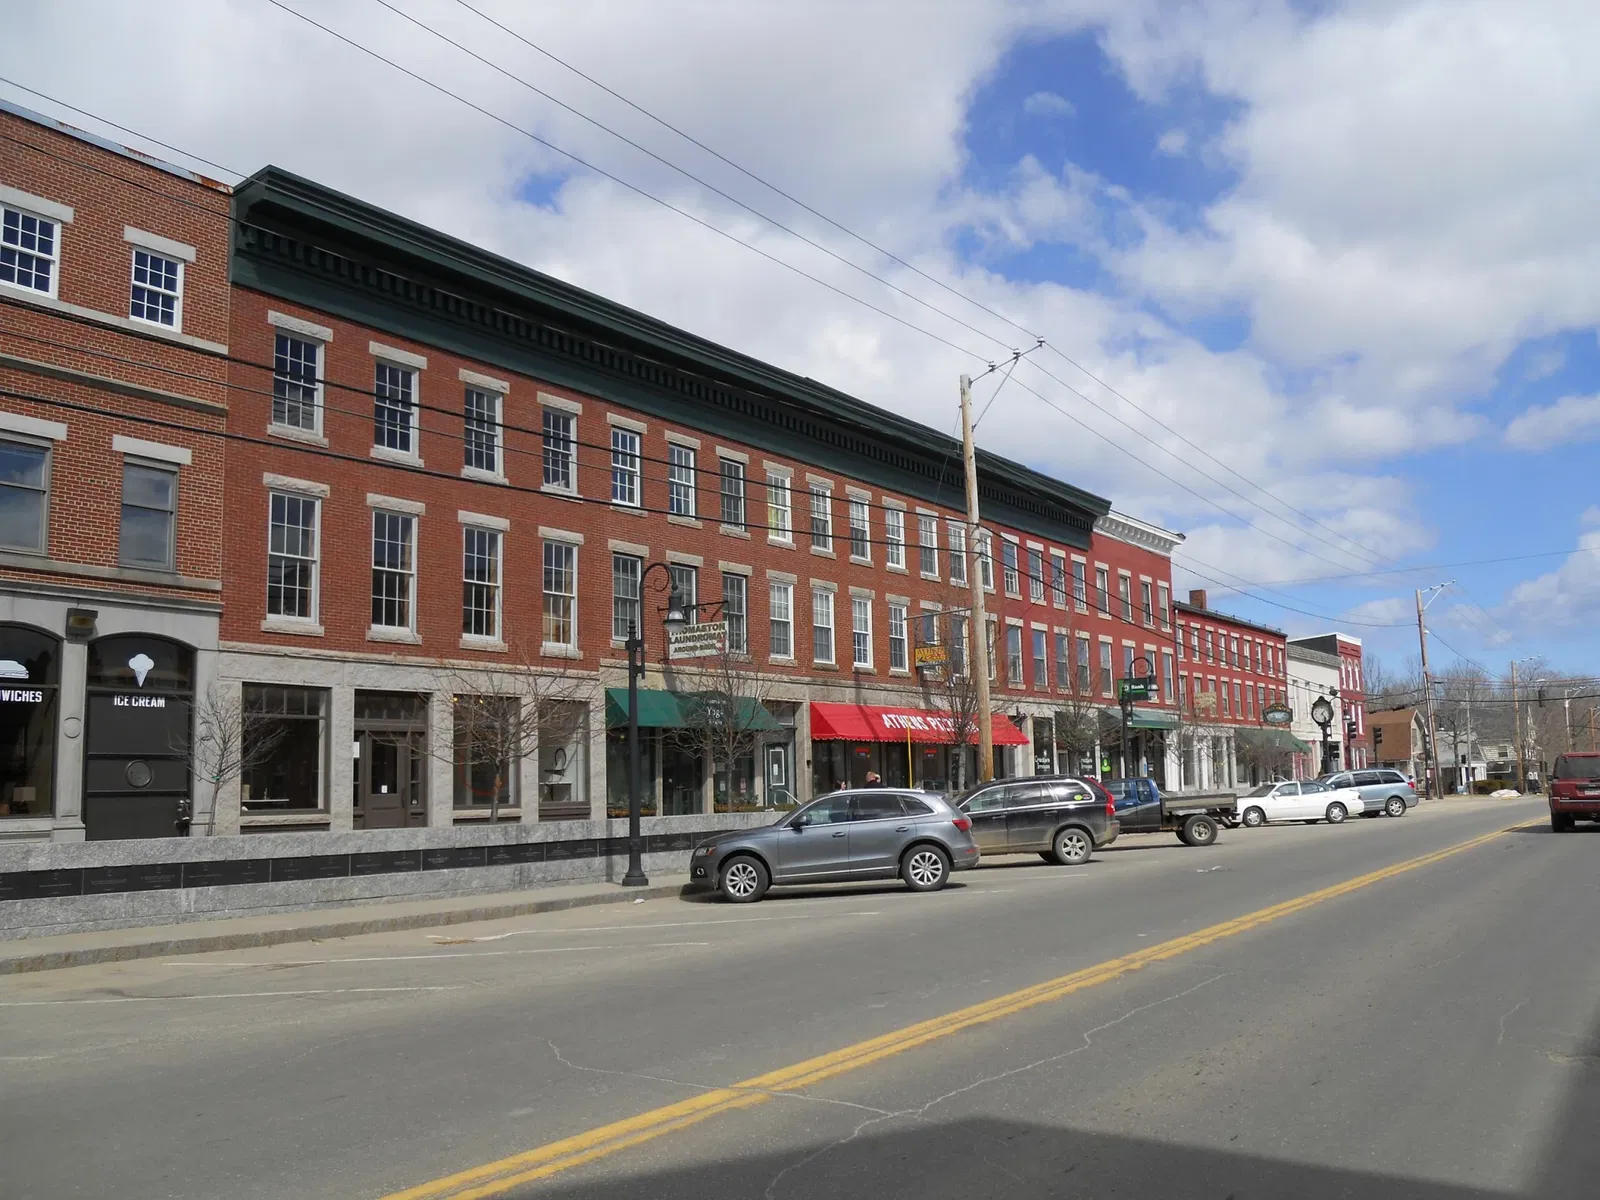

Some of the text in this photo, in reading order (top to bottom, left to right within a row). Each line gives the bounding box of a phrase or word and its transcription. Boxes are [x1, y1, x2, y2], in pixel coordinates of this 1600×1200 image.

[671, 622, 726, 636] OMASTON
[0, 689, 43, 702] WICHES
[114, 695, 165, 708] ICE CREAM
[882, 714, 979, 732] ATHENS PIZA
